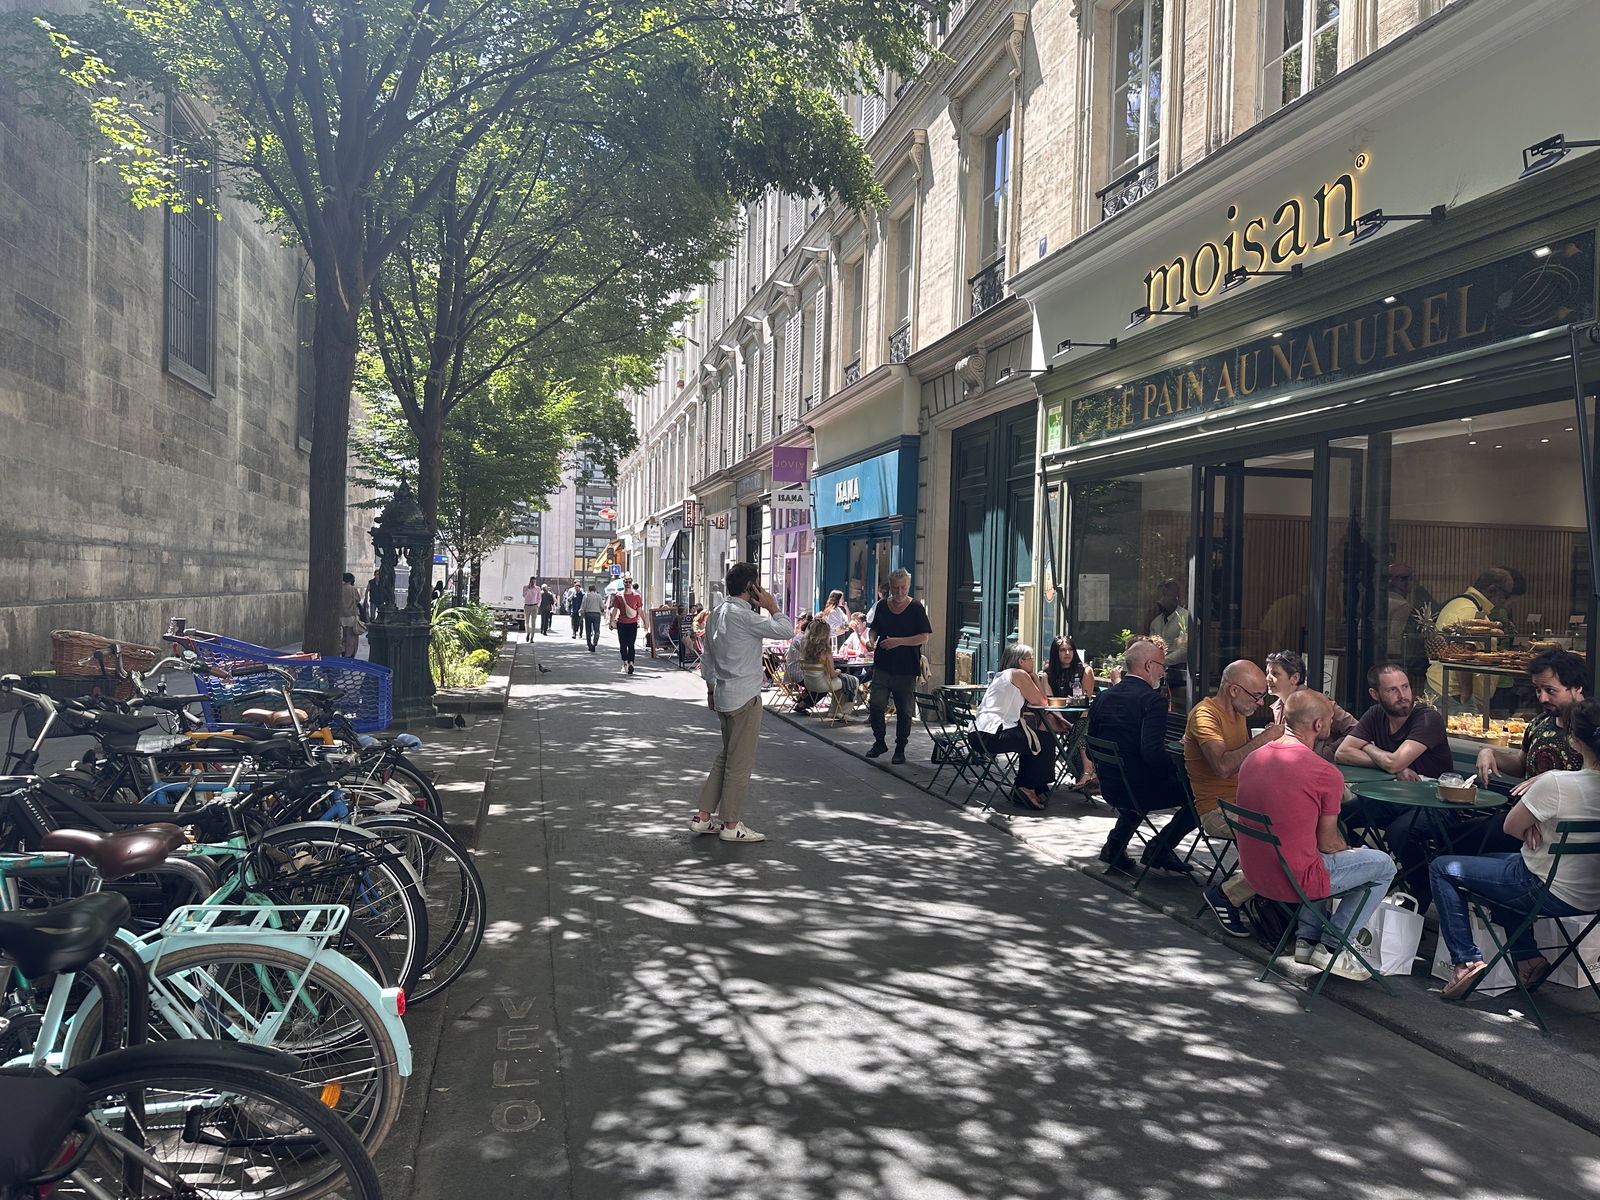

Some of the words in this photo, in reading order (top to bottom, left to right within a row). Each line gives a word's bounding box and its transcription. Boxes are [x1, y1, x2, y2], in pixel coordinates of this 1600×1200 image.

[1106, 389, 1134, 430] LE
[1143, 367, 1204, 421] PAIN
[1213, 351, 1260, 403] AU
[1269, 284, 1488, 388] NATUREL
[23, 797, 46, 826] SWAPFIETS
